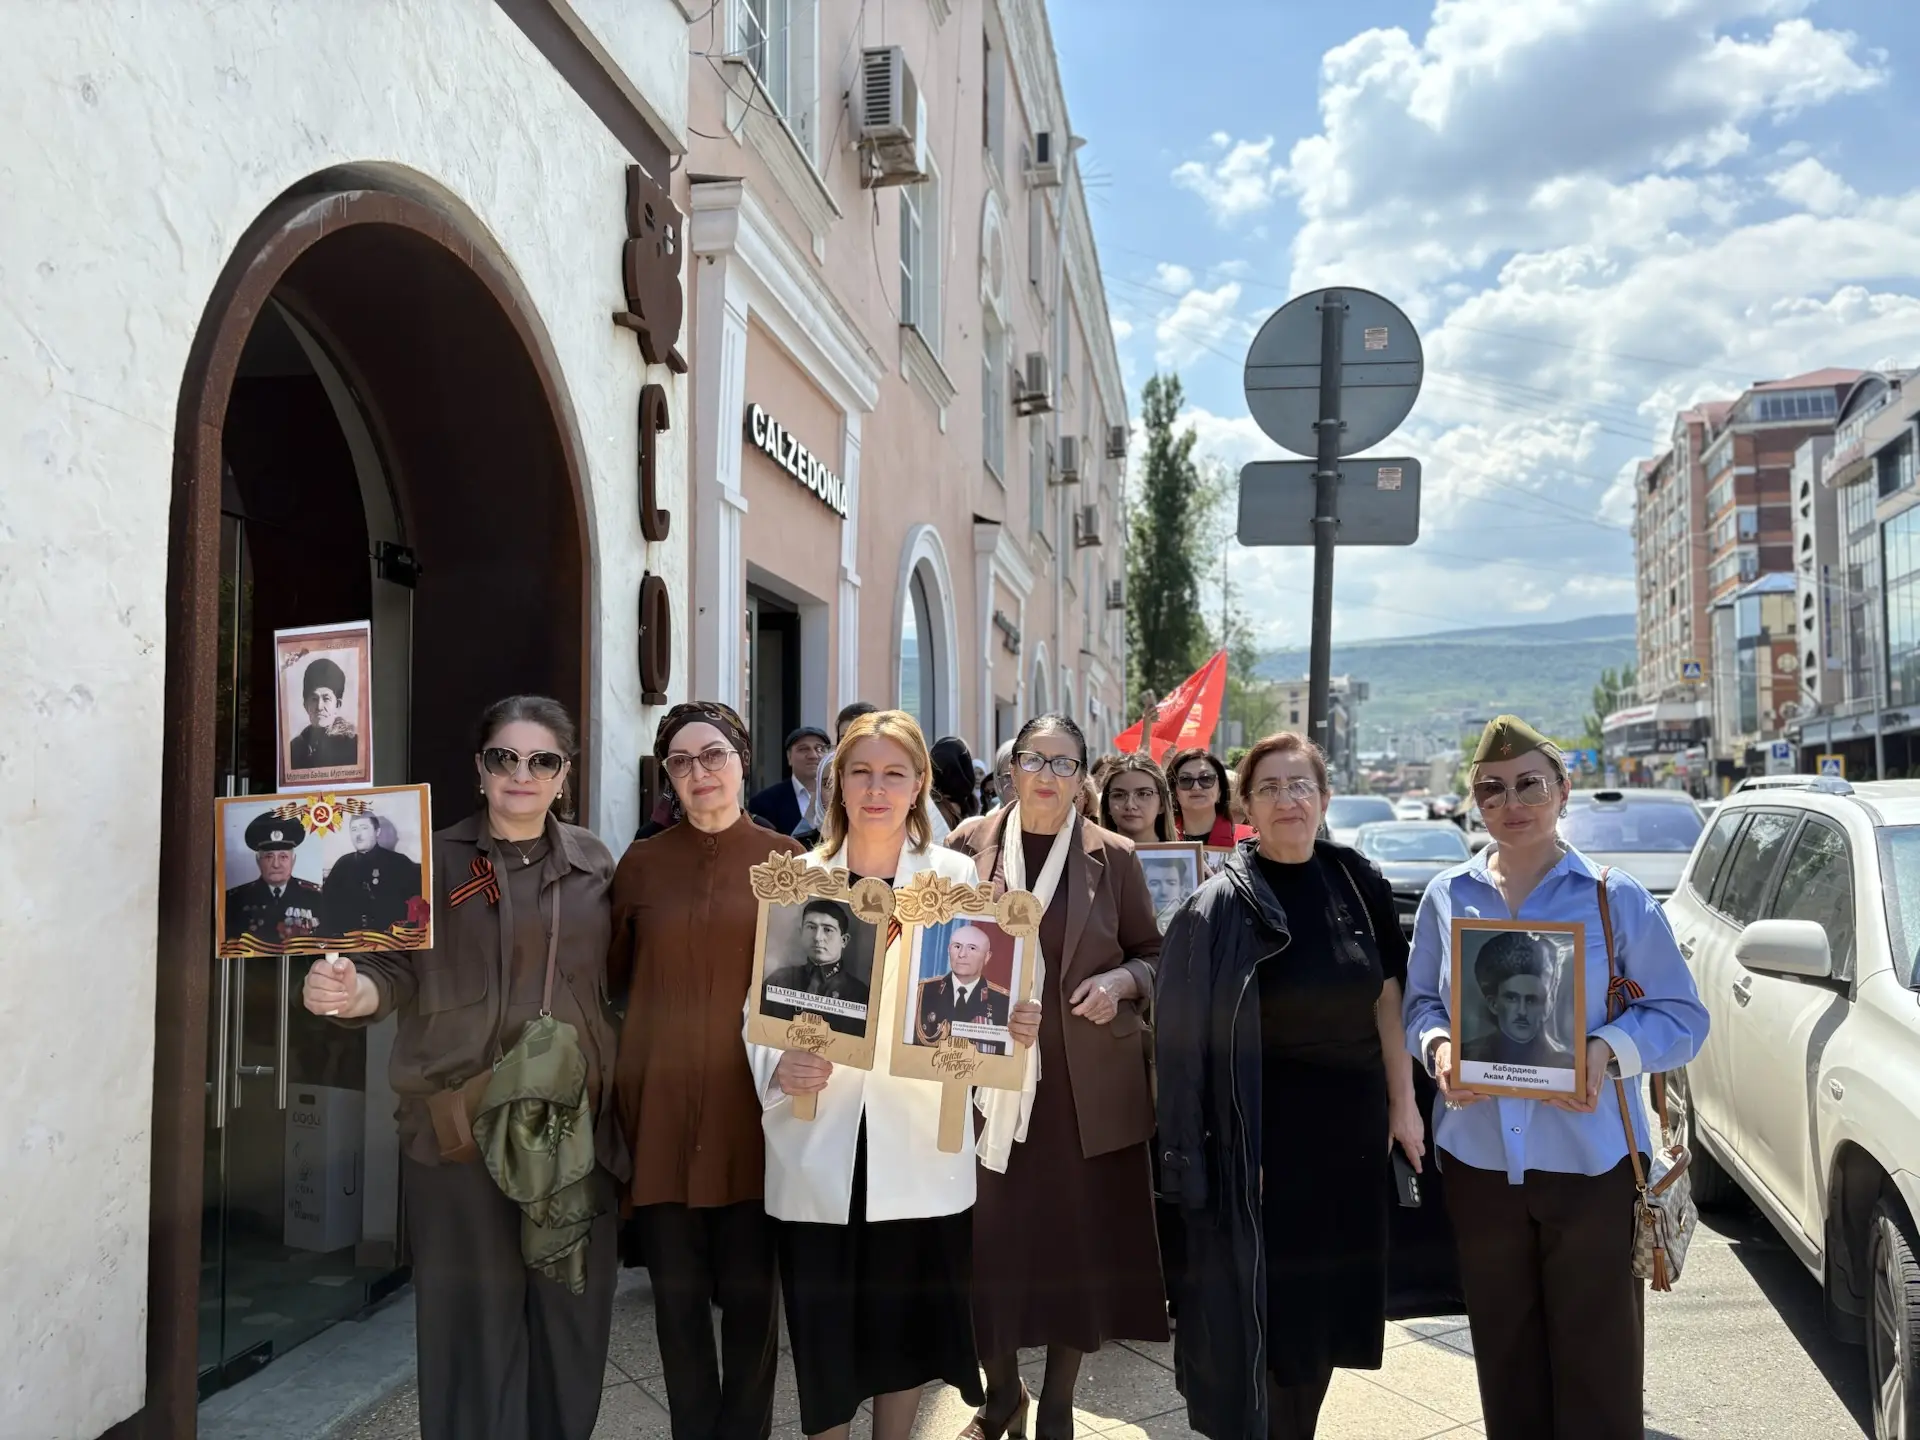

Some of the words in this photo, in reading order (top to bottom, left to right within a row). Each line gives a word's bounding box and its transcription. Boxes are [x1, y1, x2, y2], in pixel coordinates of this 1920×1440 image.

[747, 402, 848, 519] CALZEDONIA
[807, 1013, 822, 1025] МАЯ
[947, 1036, 953, 1048] 9
[953, 1037, 969, 1049] МАЯ
[1492, 1064, 1538, 1075] Кабардиев
[1483, 1072, 1504, 1080] Акам
[1506, 1074, 1550, 1084] Алимович
